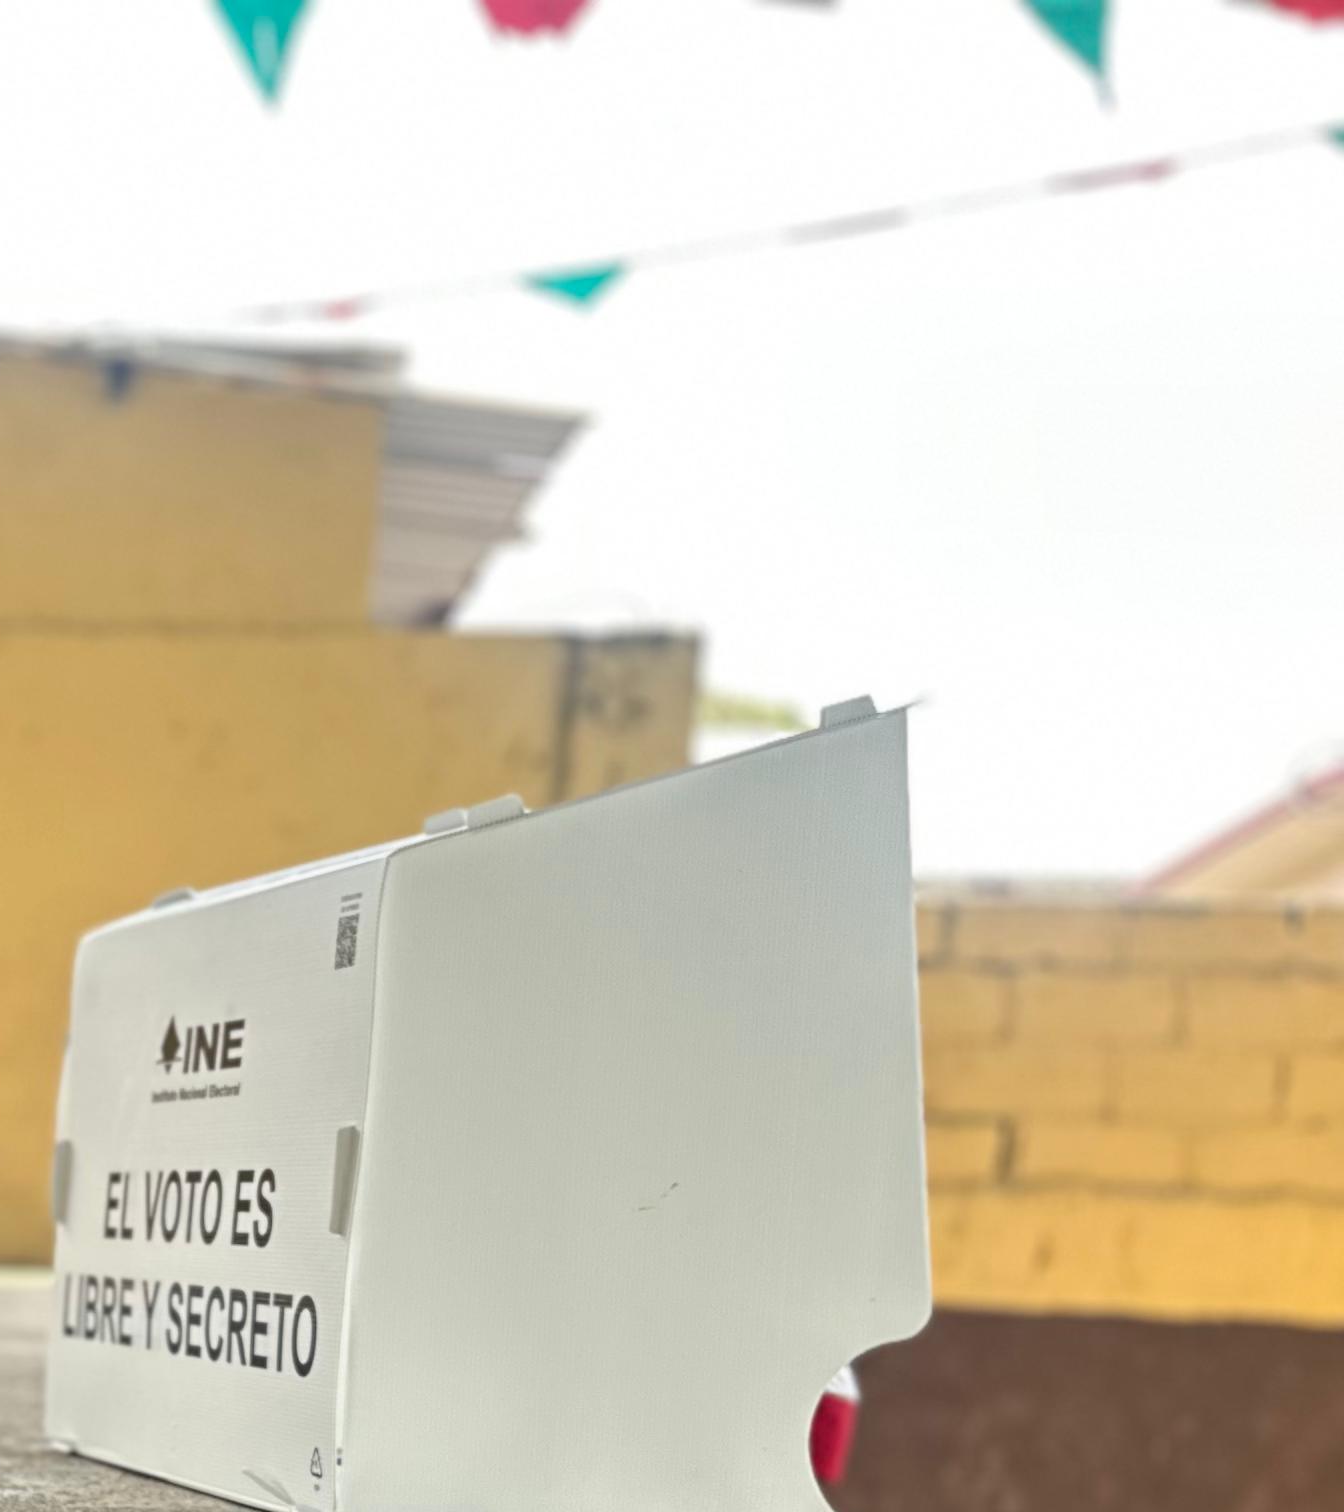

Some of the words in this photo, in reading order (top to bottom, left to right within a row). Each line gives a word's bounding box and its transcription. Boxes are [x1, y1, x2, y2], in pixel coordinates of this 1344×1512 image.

[183, 1018, 245, 1074] INE
[104, 1172, 133, 1240] EL
[145, 1169, 223, 1245] VOTO
[231, 1168, 275, 1248] ES
[63, 1273, 134, 1346] LIBRE
[142, 1280, 161, 1350] Y
[166, 1282, 317, 1377] SECRETO
